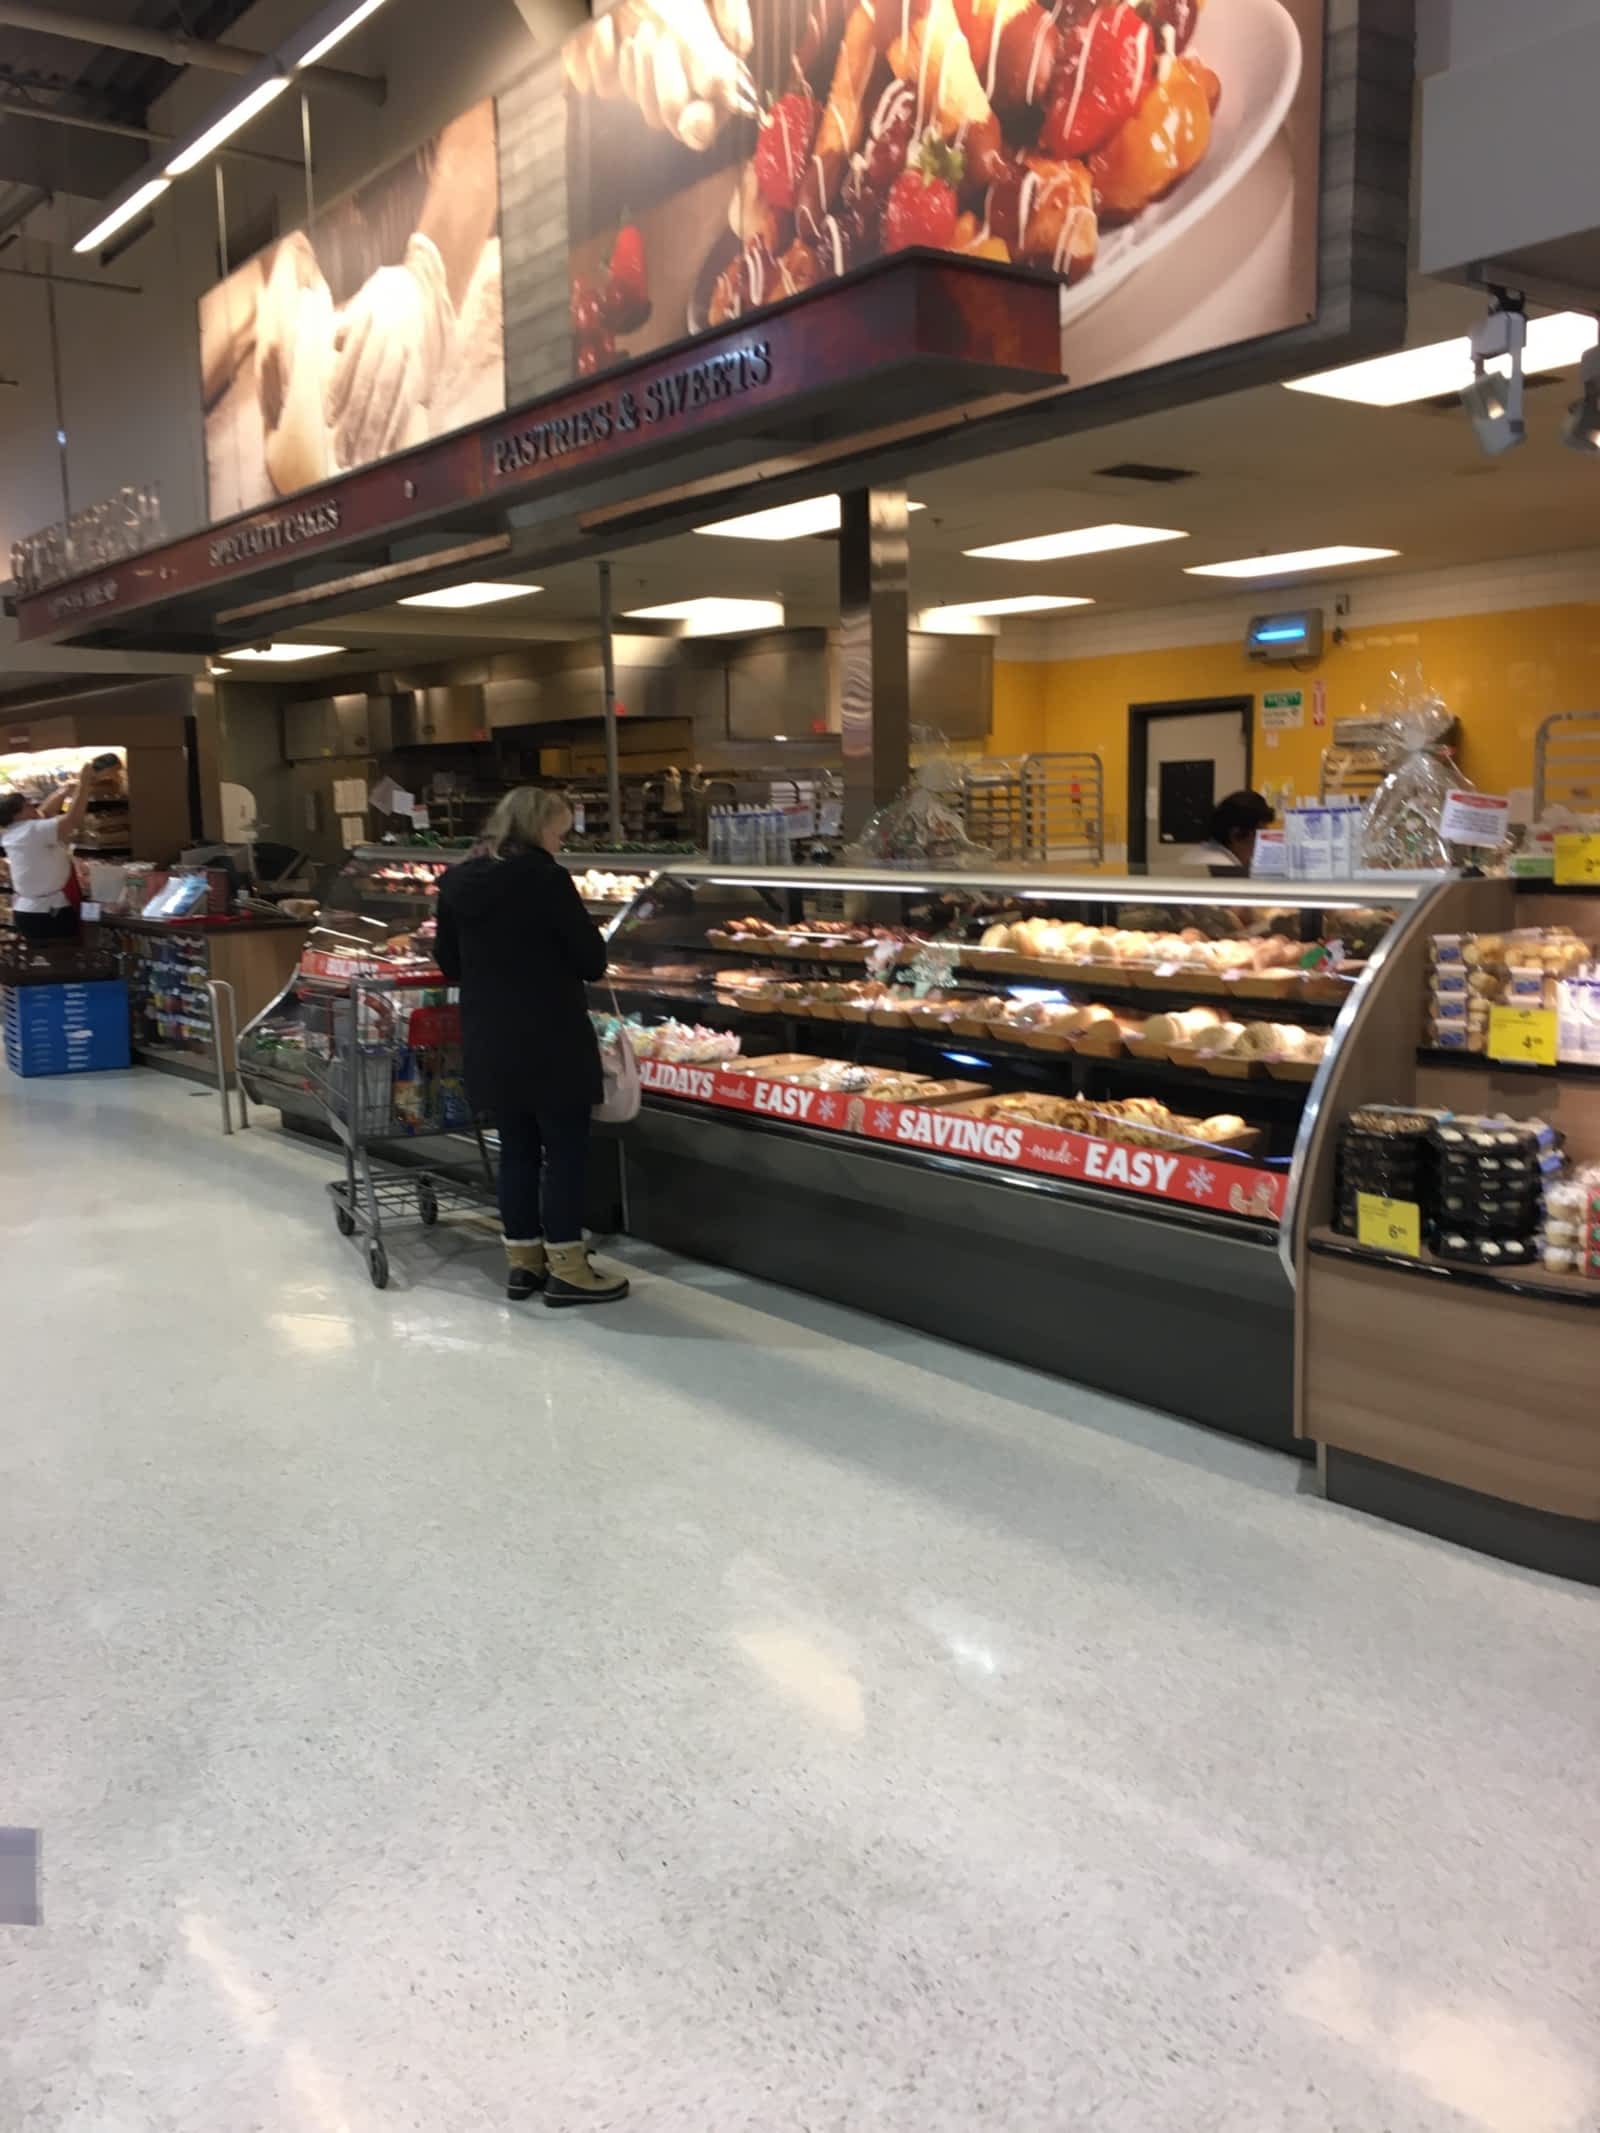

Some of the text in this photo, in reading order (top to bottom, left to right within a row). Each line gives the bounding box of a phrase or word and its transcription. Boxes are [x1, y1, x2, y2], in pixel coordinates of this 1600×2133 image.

[493, 341, 772, 475] PASTRIES & SWEETS
[284, 499, 339, 543] CAKES
[753, 1082, 815, 1119] EASY
[897, 1109, 1023, 1161] SAVINGS
[1084, 1141, 1179, 1191] EASY
